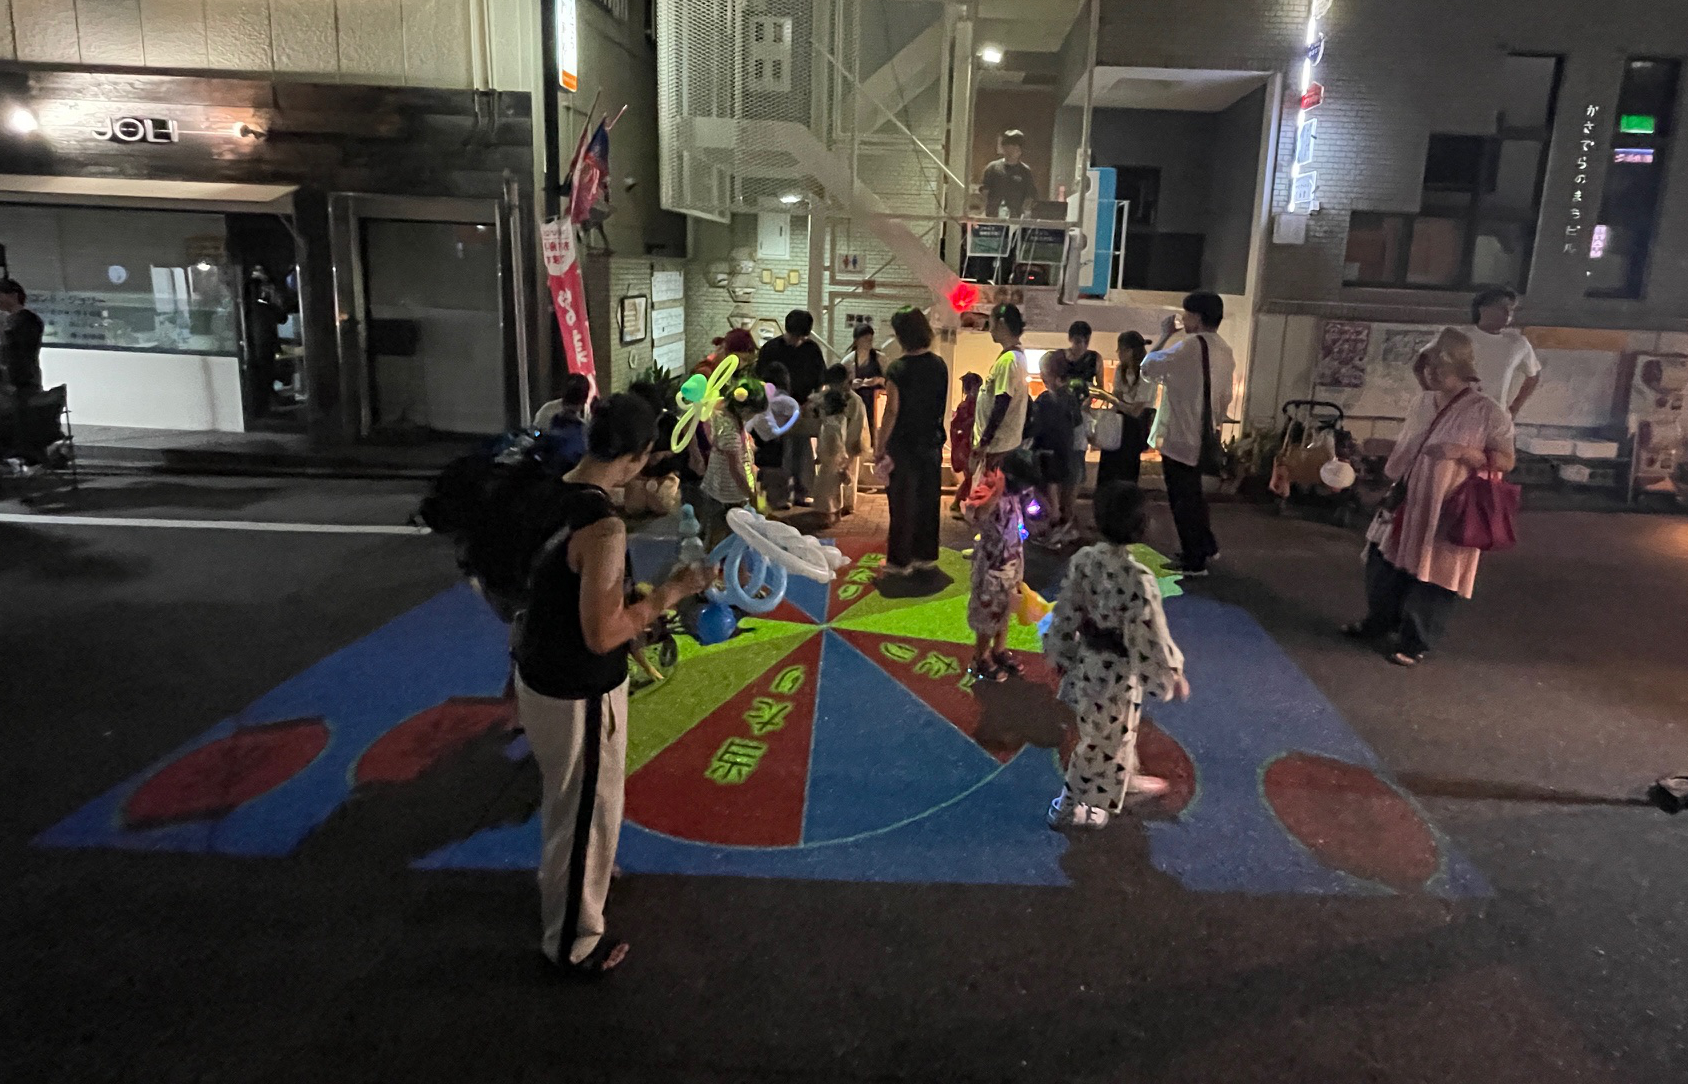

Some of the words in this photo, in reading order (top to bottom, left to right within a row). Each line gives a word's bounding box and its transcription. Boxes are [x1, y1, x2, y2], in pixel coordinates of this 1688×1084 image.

[91, 116, 179, 142] JOLI
[1563, 104, 1599, 254] かさでらのまちビル
[706, 666, 804, 782] 当たり
